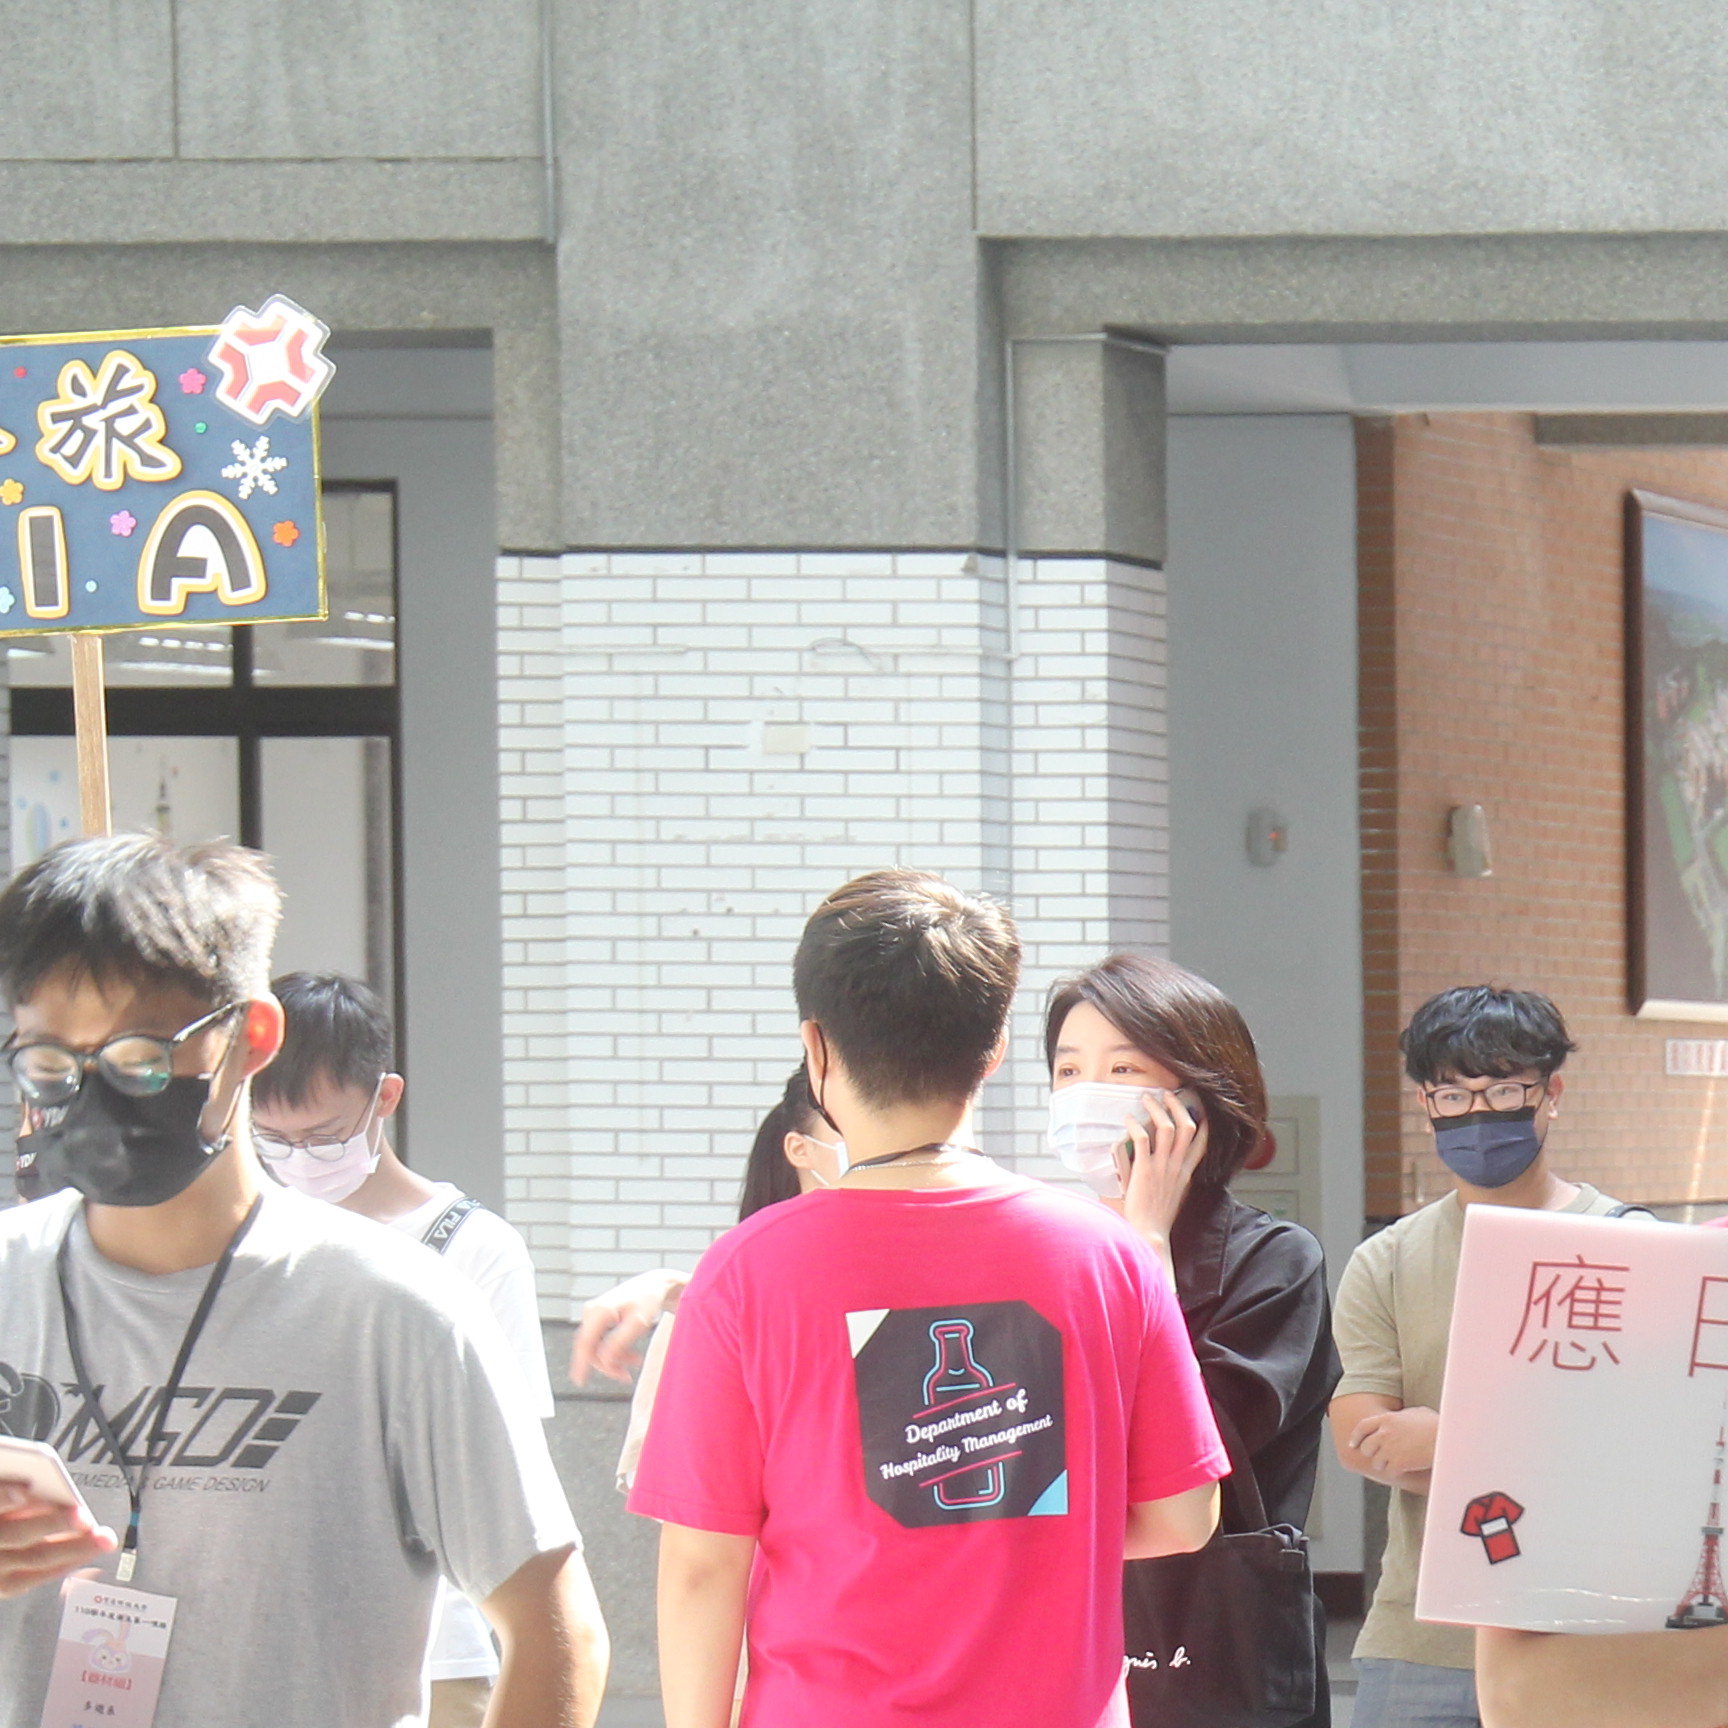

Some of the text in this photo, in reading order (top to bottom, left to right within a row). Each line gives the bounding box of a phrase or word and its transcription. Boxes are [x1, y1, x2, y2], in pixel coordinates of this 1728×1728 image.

[0, 350, 183, 490] 旅
[434, 1211, 462, 1239] FILA
[904, 1388, 1028, 1444] Department of
[879, 1414, 1053, 1480] Hospitality Management
[153, 1475, 201, 1492] GAME
[202, 1476, 272, 1494] DESIGN
